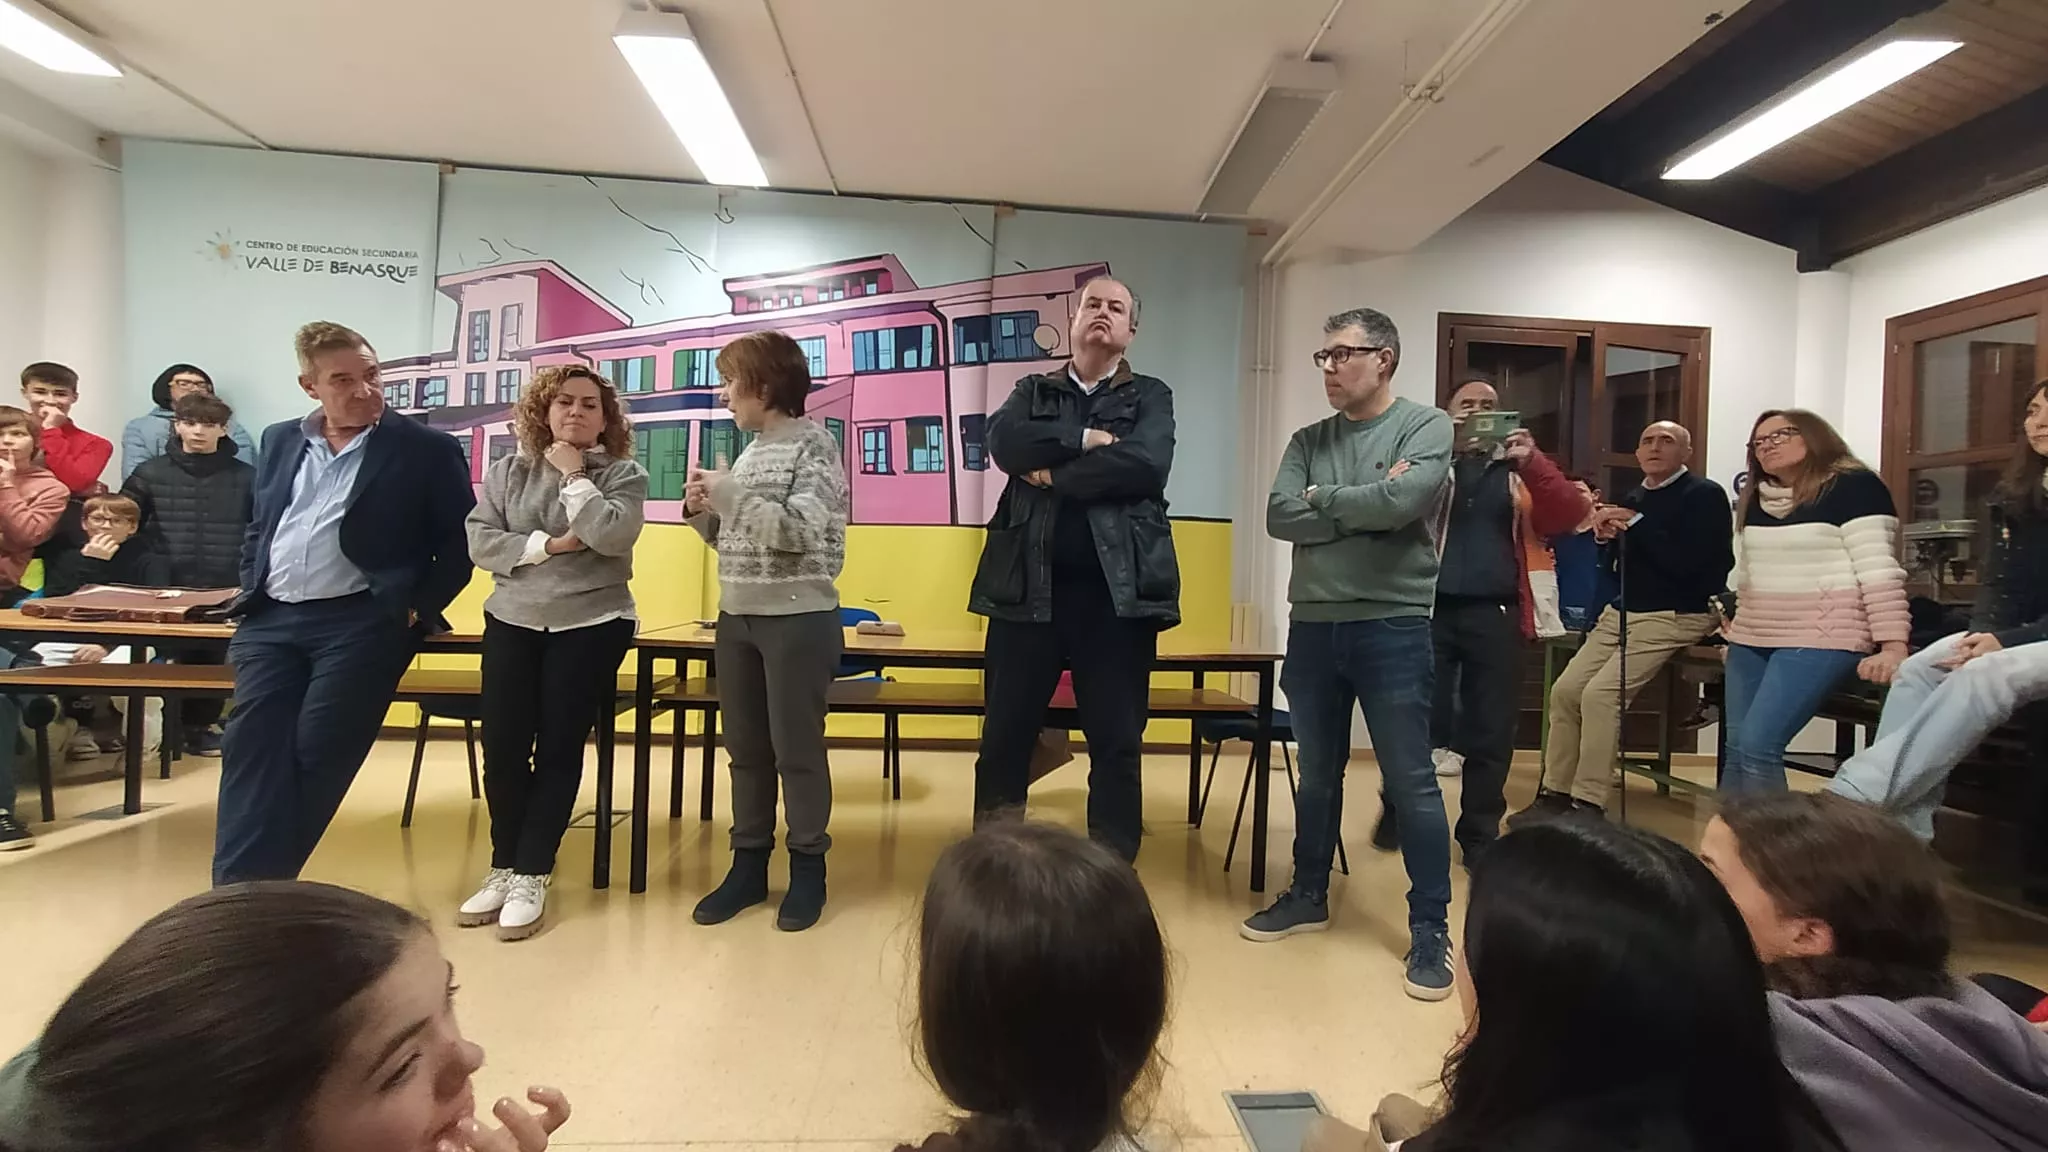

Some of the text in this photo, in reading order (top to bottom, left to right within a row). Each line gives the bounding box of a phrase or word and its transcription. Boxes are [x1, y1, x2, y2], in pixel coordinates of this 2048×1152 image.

[246, 240, 283, 251] CENTRO
[287, 243, 298, 252] DE
[362, 248, 419, 259] SECUNDARIA
[245, 256, 418, 284] VALLE DE BENASQUE
